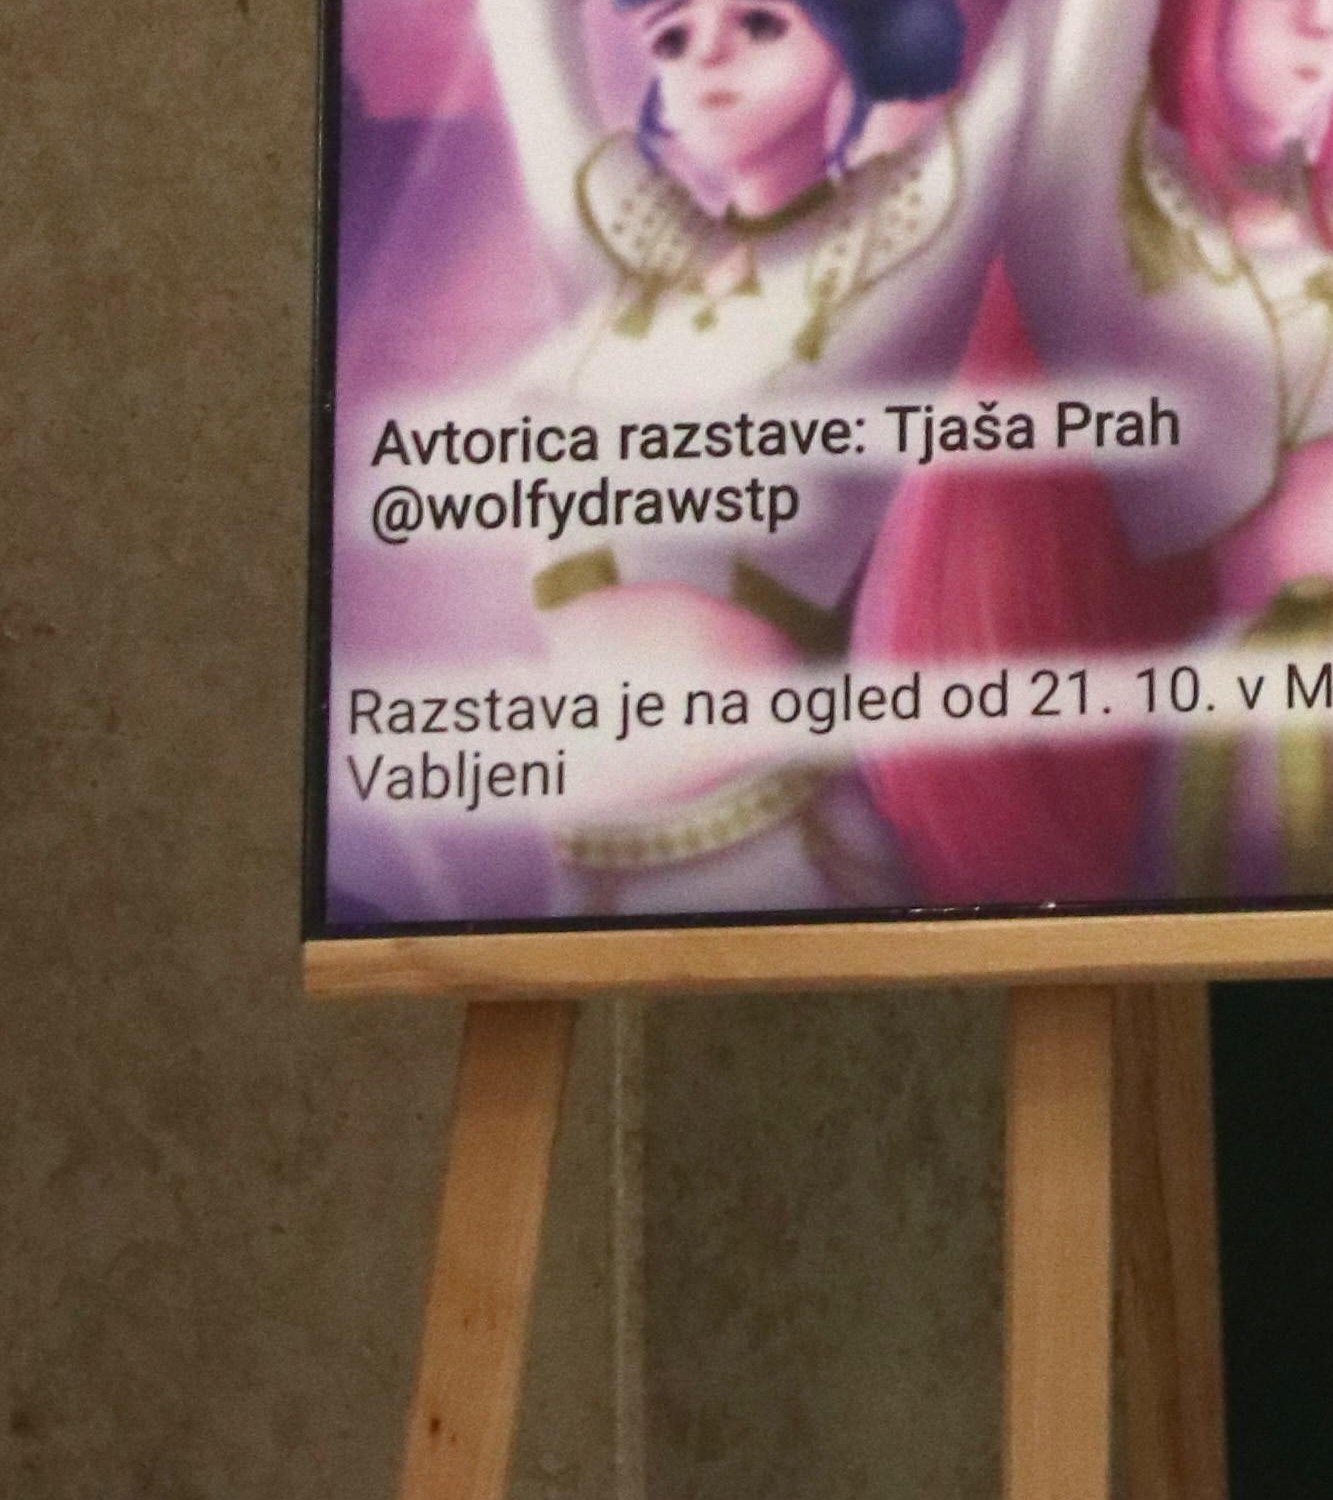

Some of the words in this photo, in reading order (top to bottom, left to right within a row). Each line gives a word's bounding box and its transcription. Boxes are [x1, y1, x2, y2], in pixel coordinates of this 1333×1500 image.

[371, 416, 600, 468] Avtorica
[617, 411, 867, 462] razstave:
[885, 402, 1036, 465] Tjaša
[1055, 397, 1181, 449] Prah
[371, 475, 800, 545] @wolfydrawstp
[348, 687, 600, 736] Razstava
[615, 682, 665, 740] je
[684, 689, 749, 726] na
[770, 671, 923, 736] ogled
[943, 669, 1009, 719] od
[1029, 668, 1112, 717] 21.
[1136, 665, 1215, 714] 10.
[1237, 673, 1265, 710] v
[348, 749, 568, 812] Vabljeni
